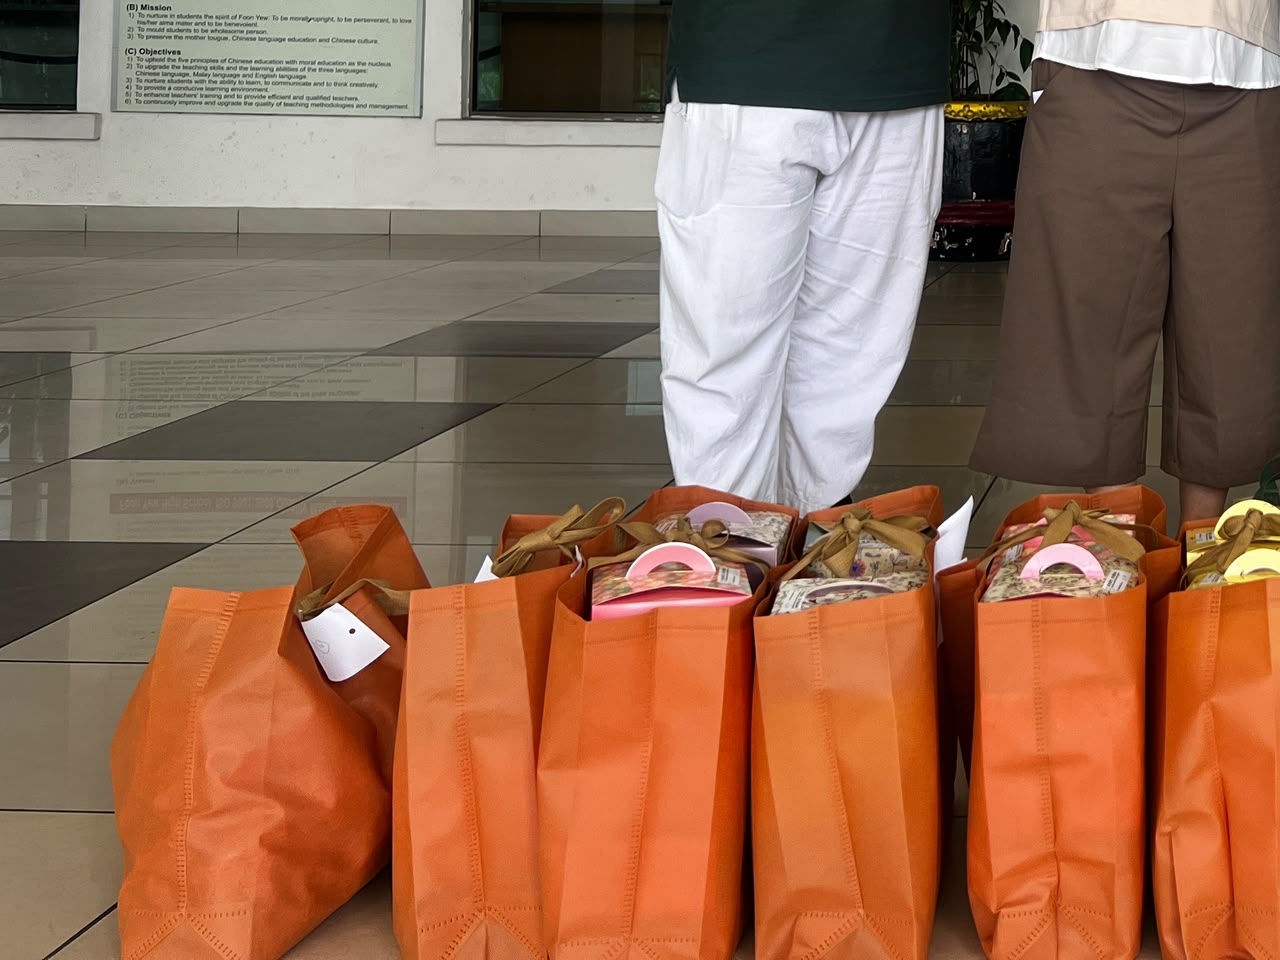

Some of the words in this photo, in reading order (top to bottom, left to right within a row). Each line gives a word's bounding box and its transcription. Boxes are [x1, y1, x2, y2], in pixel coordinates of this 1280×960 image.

[126, 4, 138, 12] (B)
[140, 4, 172, 12] Mission
[124, 48, 136, 56] (C)
[138, 48, 181, 58] Objectives
